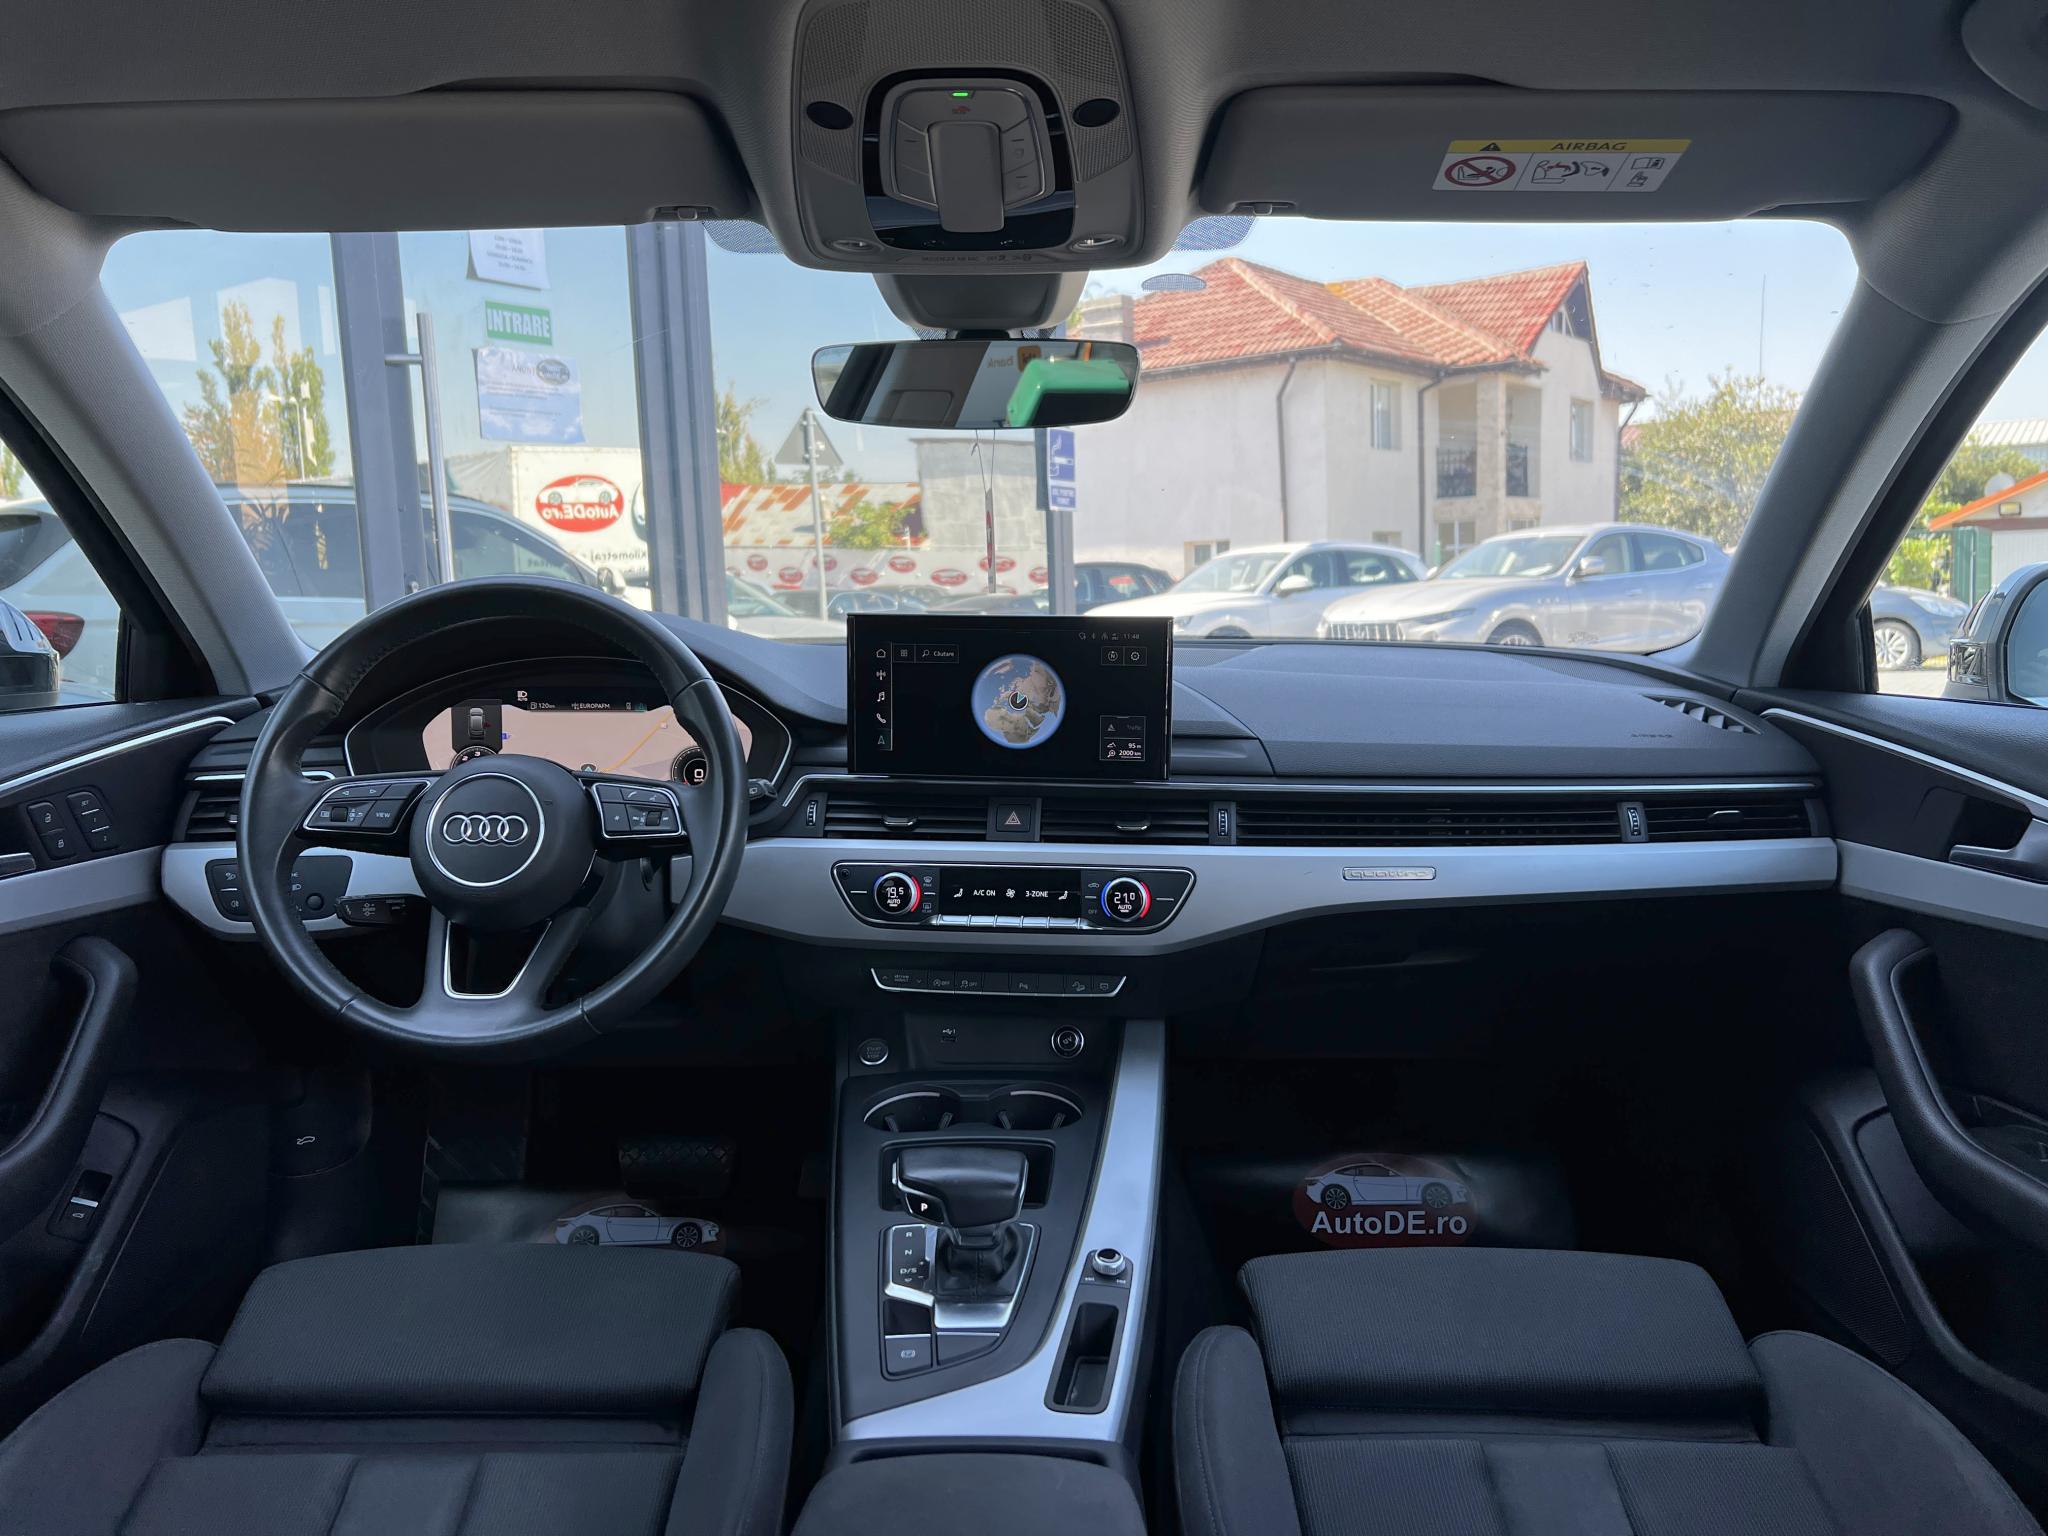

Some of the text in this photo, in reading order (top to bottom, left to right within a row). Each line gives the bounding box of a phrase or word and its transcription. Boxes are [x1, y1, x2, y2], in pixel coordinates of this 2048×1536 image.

[1550, 142, 1628, 151] AIRBAG
[487, 308, 551, 338] INTRARE
[694, 768, 704, 779] 0
[885, 887, 904, 898] 19.5
[973, 889, 996, 897] A/C ON
[1025, 890, 1049, 898] 3-ZONE
[920, 1202, 928, 1212] P
[1311, 1210, 1468, 1235] AutoDE.ro
